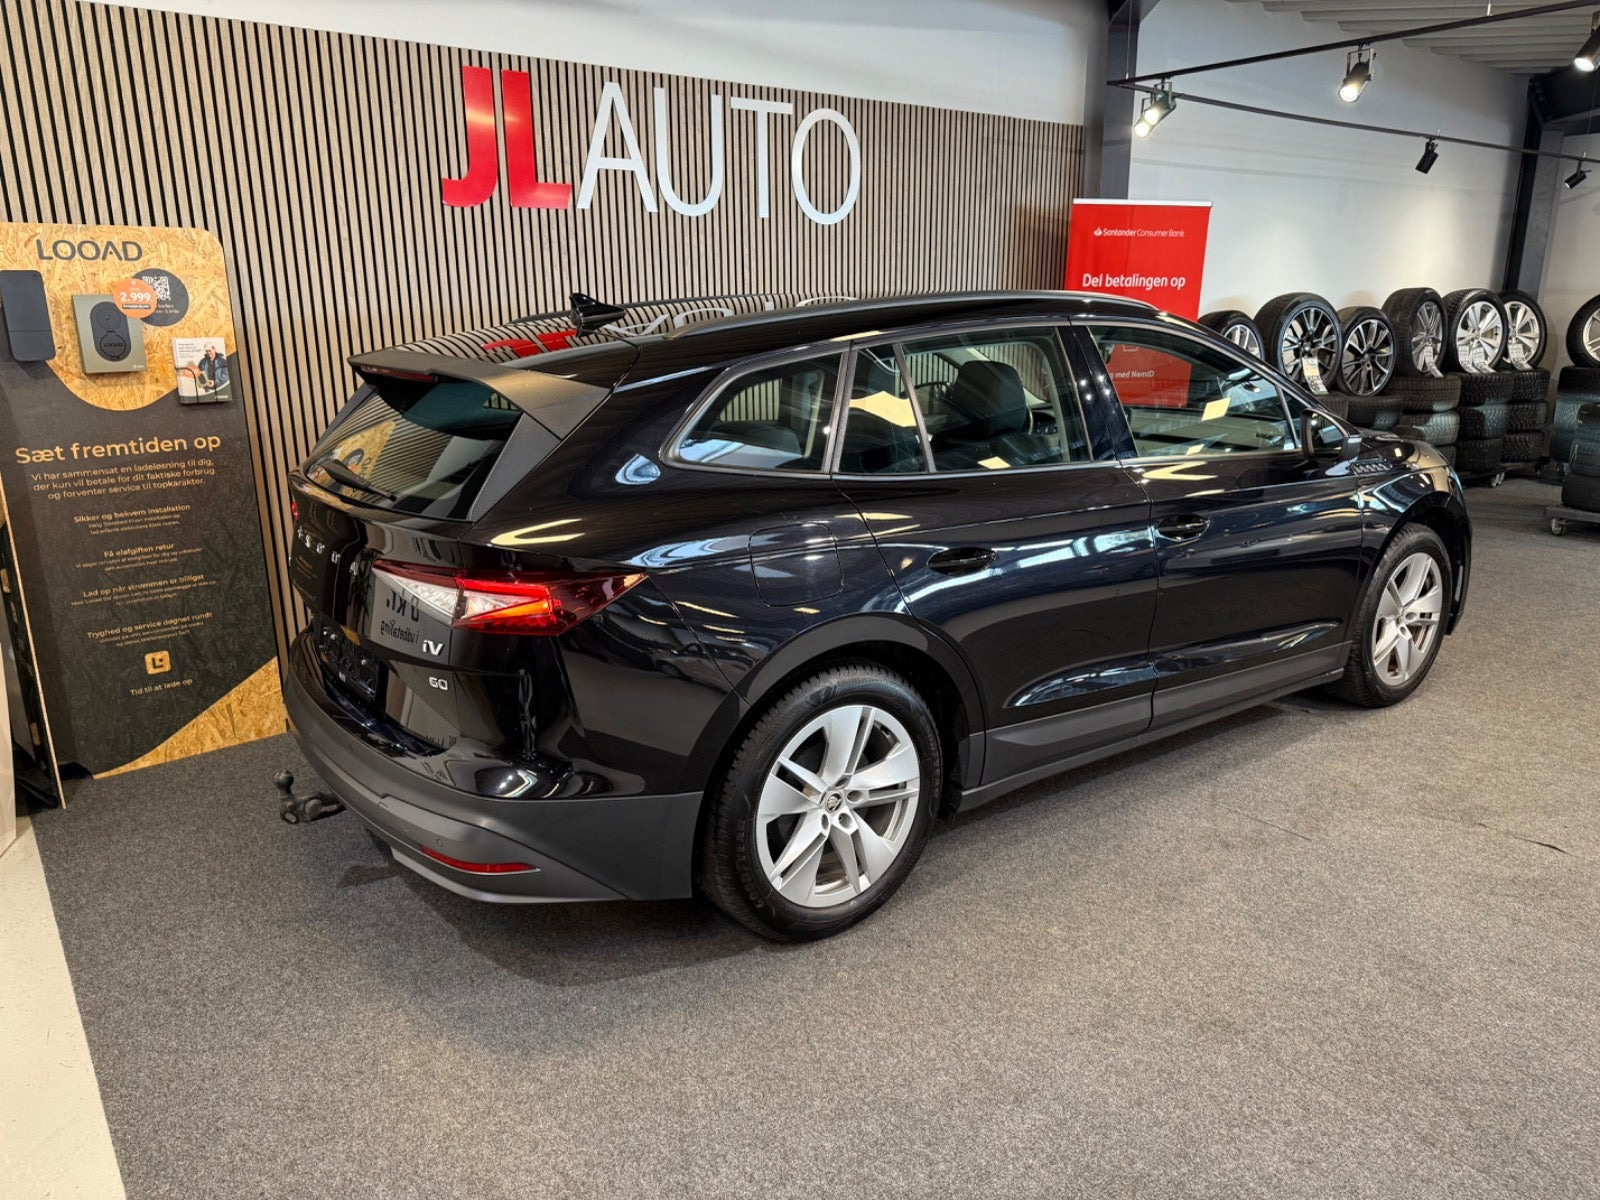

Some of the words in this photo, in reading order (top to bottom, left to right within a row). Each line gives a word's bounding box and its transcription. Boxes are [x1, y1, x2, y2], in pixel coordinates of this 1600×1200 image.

[576, 81, 861, 225] AUTO
[36, 239, 143, 261] LOOAD
[1082, 273, 1103, 288] Del
[1105, 273, 1168, 291] betalingen
[1170, 276, 1186, 291] op
[120, 292, 151, 302] 2.999
[15, 446, 65, 464] Sæt
[71, 437, 188, 460] fremtiden
[193, 435, 222, 452] op
[31, 473, 41, 481] Vi
[44, 472, 60, 480] har
[62, 466, 118, 478] sammensat
[188, 459, 196, 467] til
[33, 483, 50, 491] der
[52, 481, 71, 489] kun
[73, 479, 84, 487] vil
[86, 476, 115, 486] betale
[118, 475, 130, 483] for
[133, 474, 144, 482] dit
[146, 470, 181, 480] faktiske
[183, 467, 215, 478] forbrug
[48, 493, 61, 501] og
[64, 488, 106, 498] forventer
[109, 485, 141, 495] service
[143, 483, 152, 491] til
[101, 513, 113, 521] og
[83, 590, 98, 598] Lad
[423, 640, 444, 656] iV
[130, 688, 143, 696] Tid
[144, 686, 152, 694] til
[181, 678, 193, 687] op
[429, 677, 448, 691] 60
